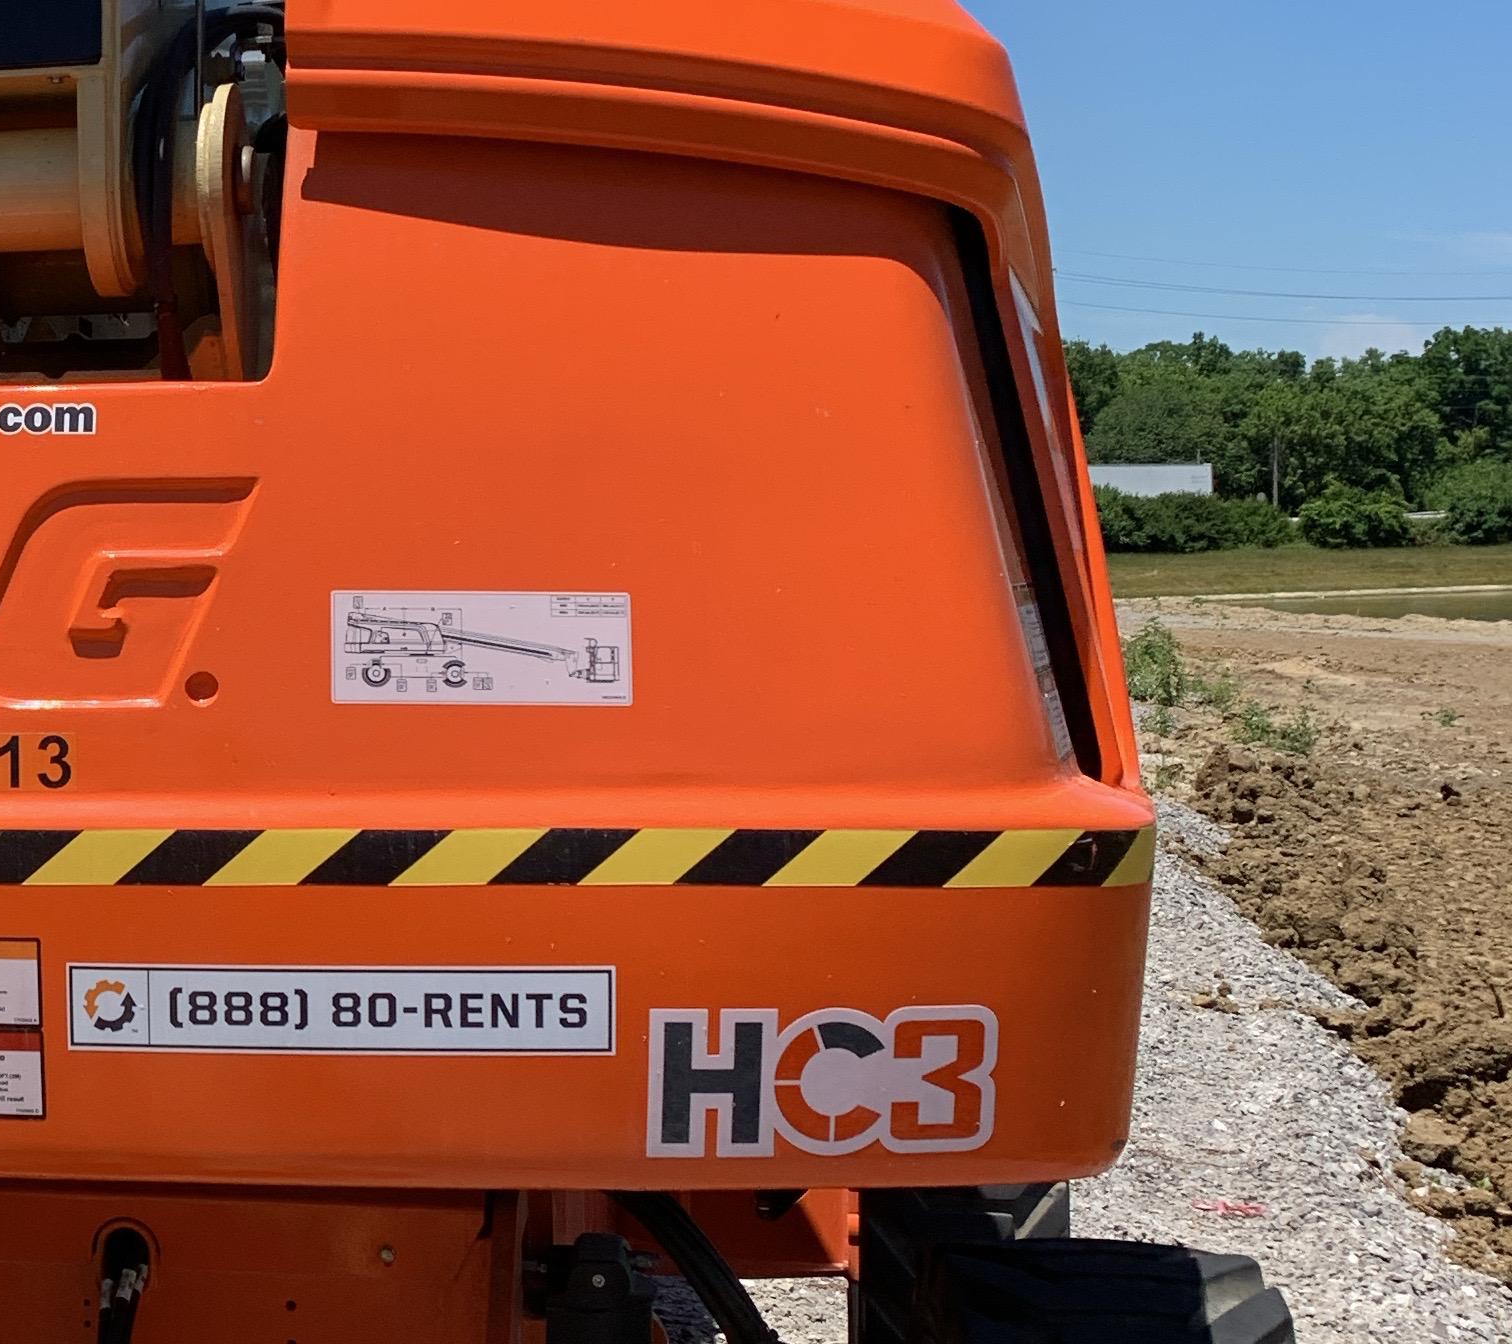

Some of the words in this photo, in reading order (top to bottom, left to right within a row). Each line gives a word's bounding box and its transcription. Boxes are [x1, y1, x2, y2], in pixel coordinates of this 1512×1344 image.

[167, 988, 309, 1031] (888)
[331, 991, 589, 1030] 80-RENTS
[653, 1009, 993, 1155] HC3
